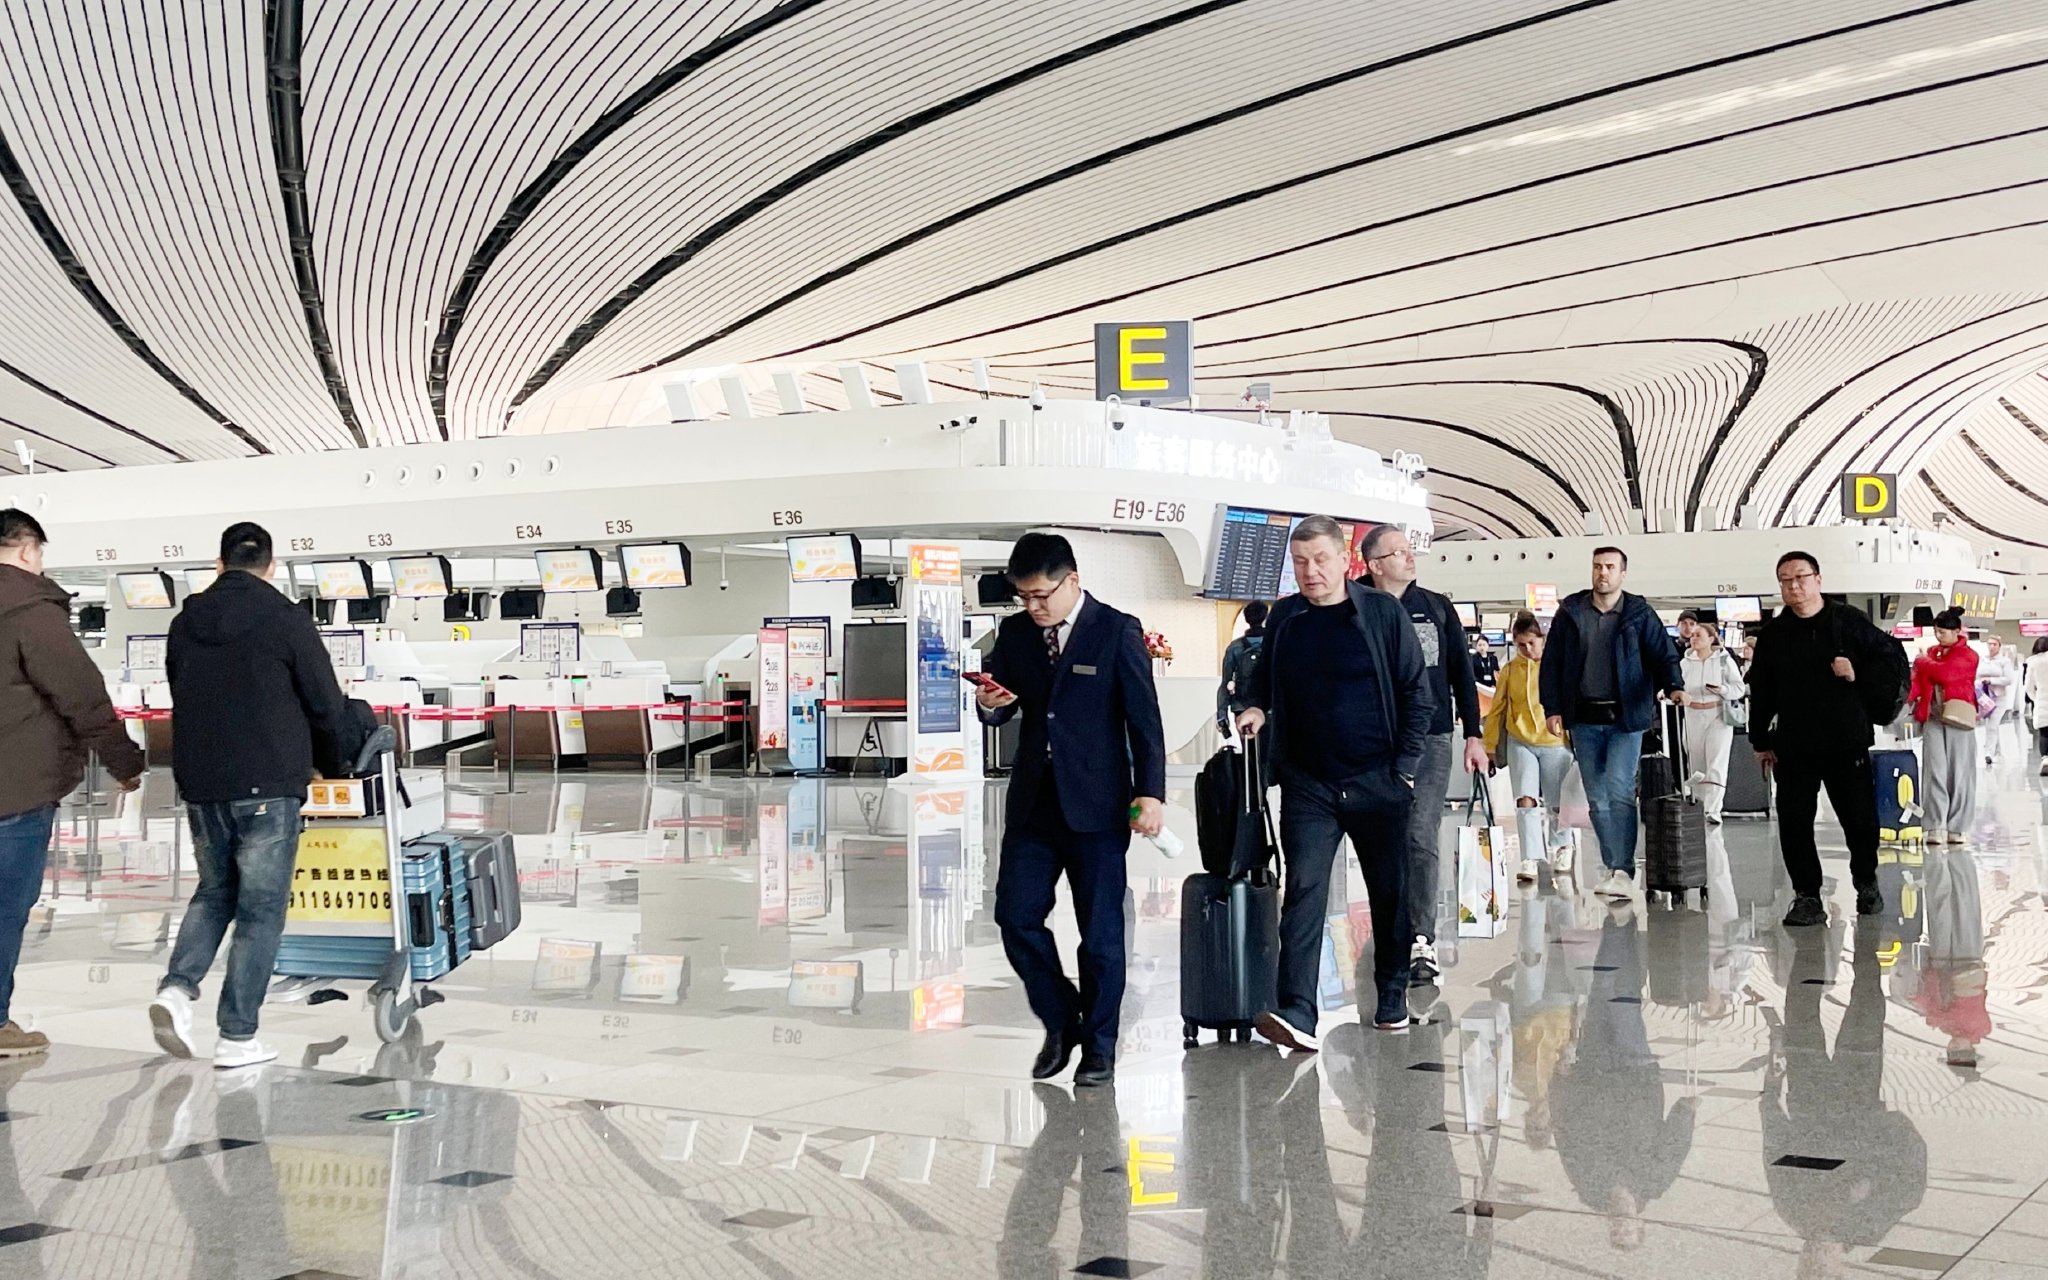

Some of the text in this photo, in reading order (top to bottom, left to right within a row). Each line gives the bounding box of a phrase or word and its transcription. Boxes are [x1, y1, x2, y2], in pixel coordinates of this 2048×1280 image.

[1119, 327, 1169, 391] E
[1855, 476, 1889, 513] D
[773, 510, 803, 526] E36
[515, 524, 543, 539] E34
[605, 519, 633, 535] E35
[291, 537, 315, 551] E32
[368, 533, 393, 547] E33
[96, 548, 117, 562] E30
[164, 545, 184, 558] E31
[1717, 583, 1738, 593] D36
